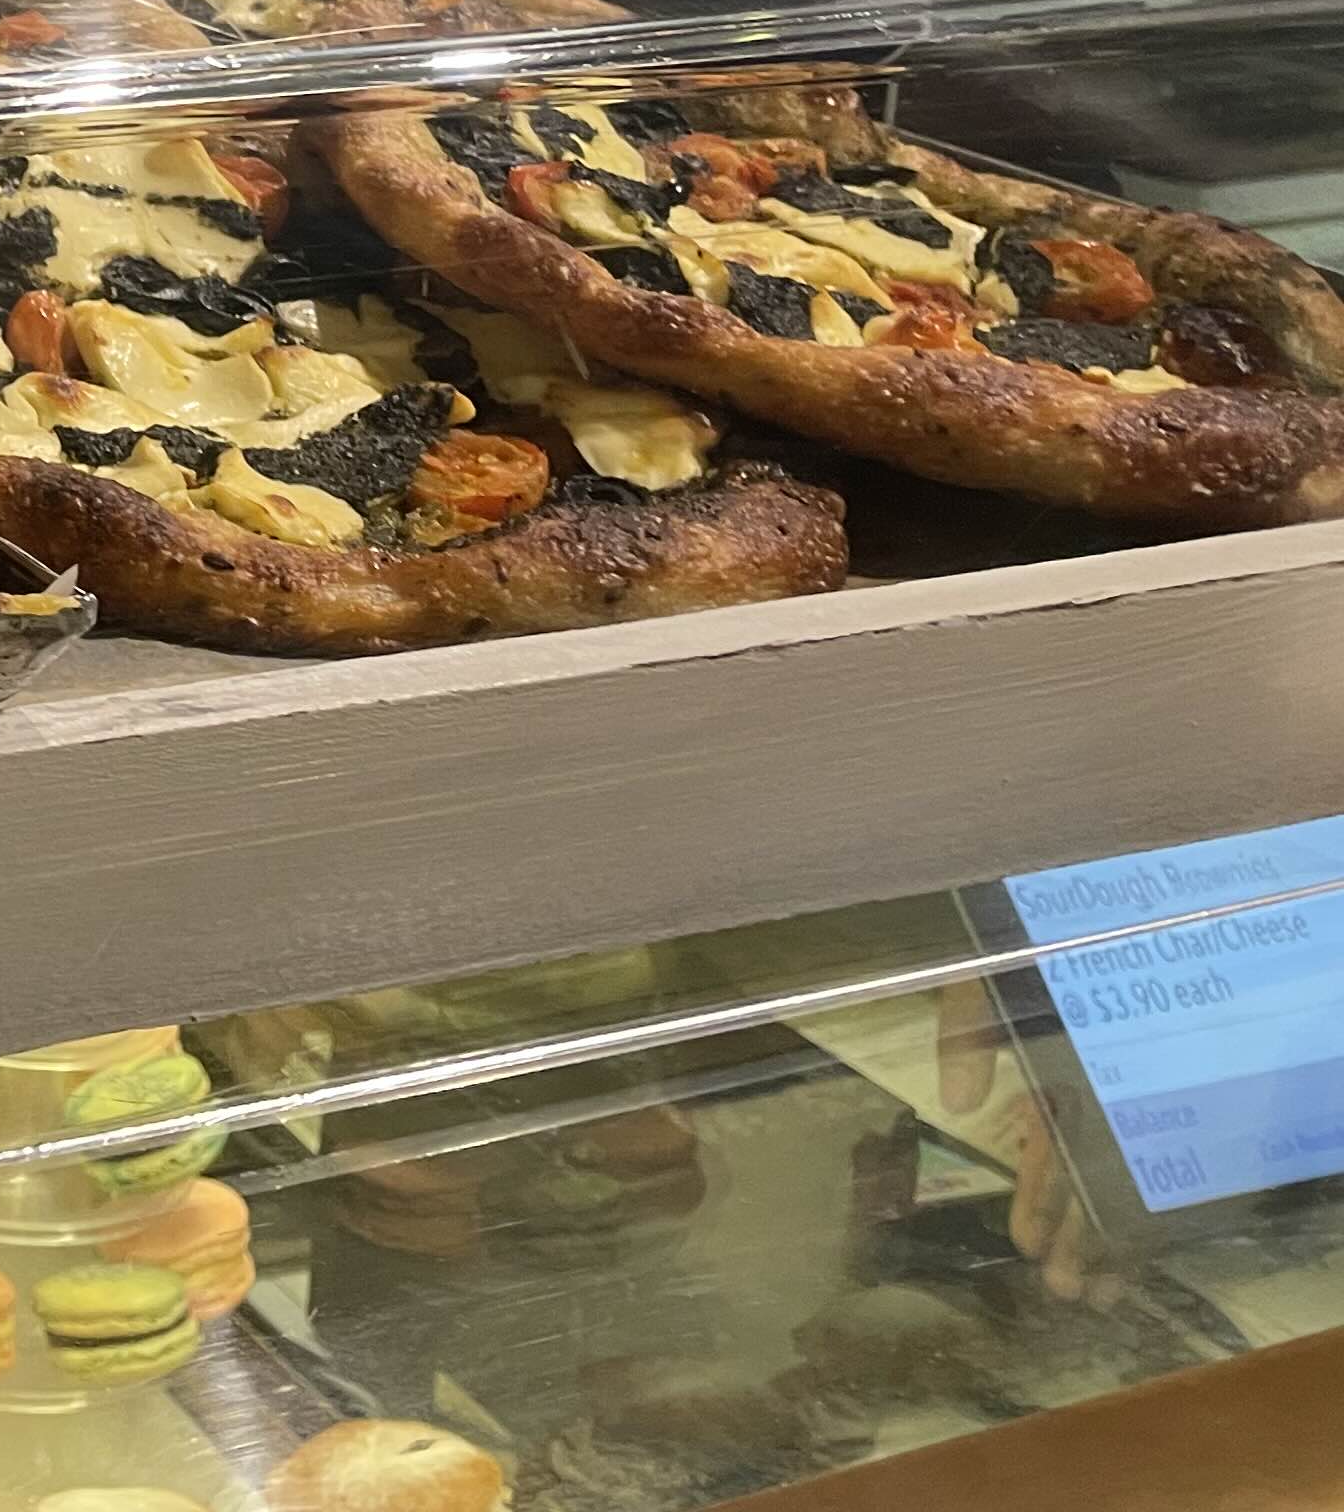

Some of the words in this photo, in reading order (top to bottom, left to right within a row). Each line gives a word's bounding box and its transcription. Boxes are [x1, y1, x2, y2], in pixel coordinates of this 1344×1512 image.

[1014, 865, 1162, 921] SourDough
[1067, 935, 1154, 979] French
[1153, 913, 1311, 964] Char/Cheese
[1062, 990, 1090, 1028] @
[1091, 978, 1171, 1024] $3.90
[1175, 968, 1235, 1009] each
[1133, 1145, 1208, 1196] Total
